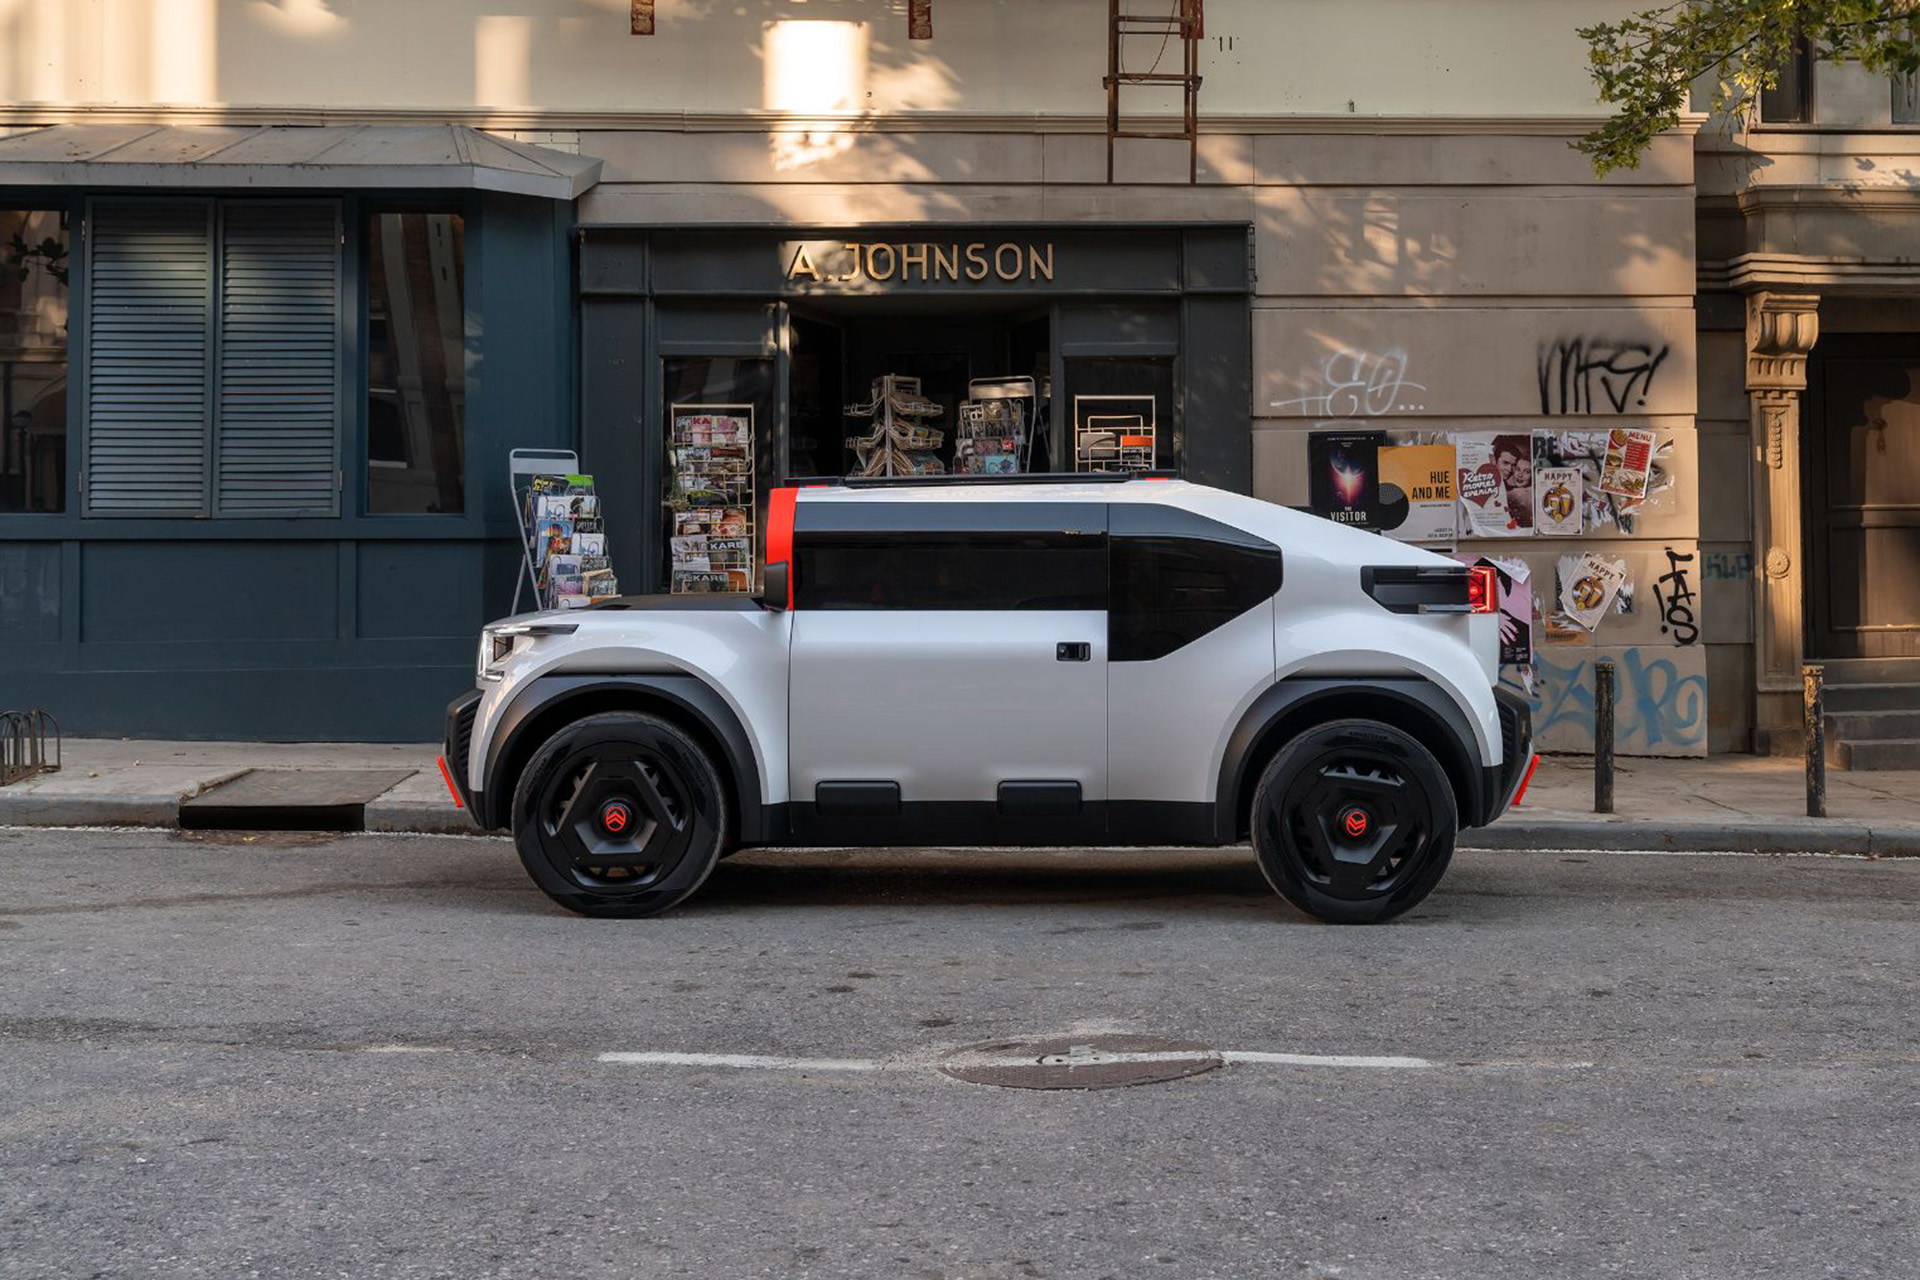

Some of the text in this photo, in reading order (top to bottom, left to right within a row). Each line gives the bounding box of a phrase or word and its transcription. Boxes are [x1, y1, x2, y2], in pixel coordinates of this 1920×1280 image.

[841, 242, 1054, 281] JOHNSON
[1628, 431, 1652, 441] MENU
[1430, 471, 1450, 484] HUE
[1462, 472, 1493, 484] Retro
[1544, 472, 1573, 480] HAPPY
[1462, 480, 1496, 492] movies
[1463, 486, 1500, 498] evening
[1411, 486, 1450, 500] AND ME
[1330, 511, 1367, 521] VISITOR
[1588, 560, 1616, 580] HAPPY
